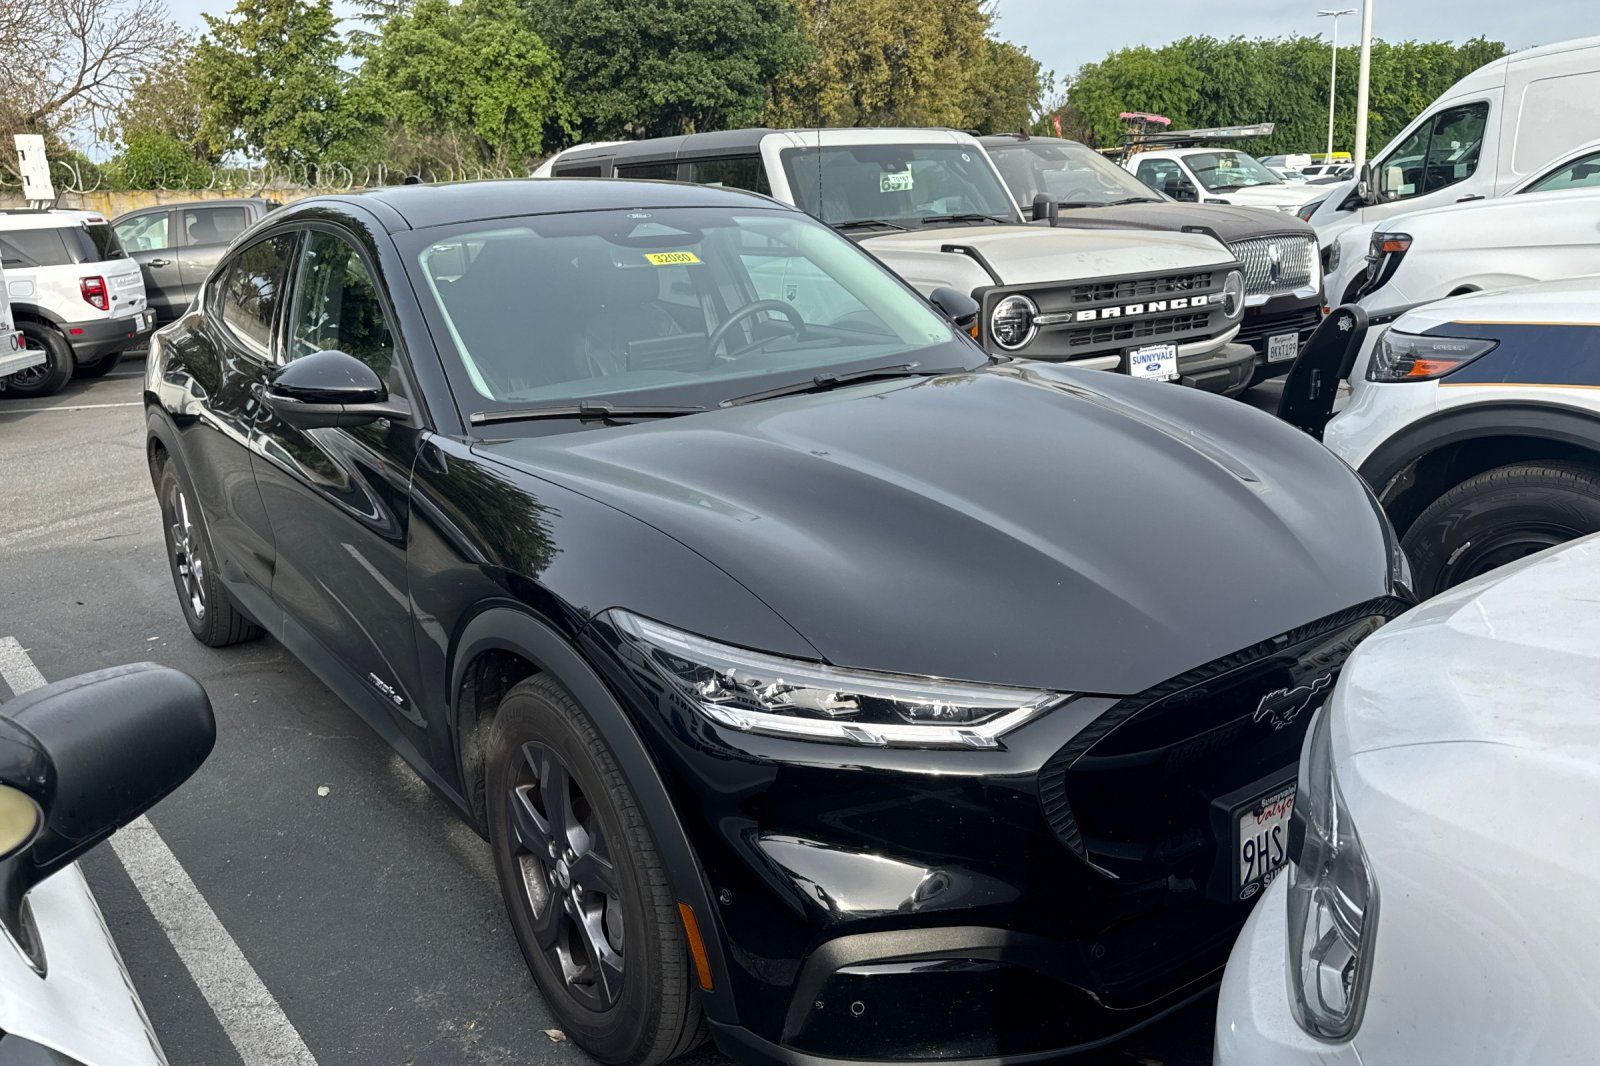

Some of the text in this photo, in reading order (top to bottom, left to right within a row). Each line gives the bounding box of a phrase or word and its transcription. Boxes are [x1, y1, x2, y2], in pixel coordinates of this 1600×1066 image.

[653, 253, 692, 263] 32080
[1076, 295, 1208, 321] BRONCO
[1132, 350, 1173, 365] SUNNYVALE
[1256, 798, 1294, 825] Califo
[1243, 825, 1284, 884] 9HS
